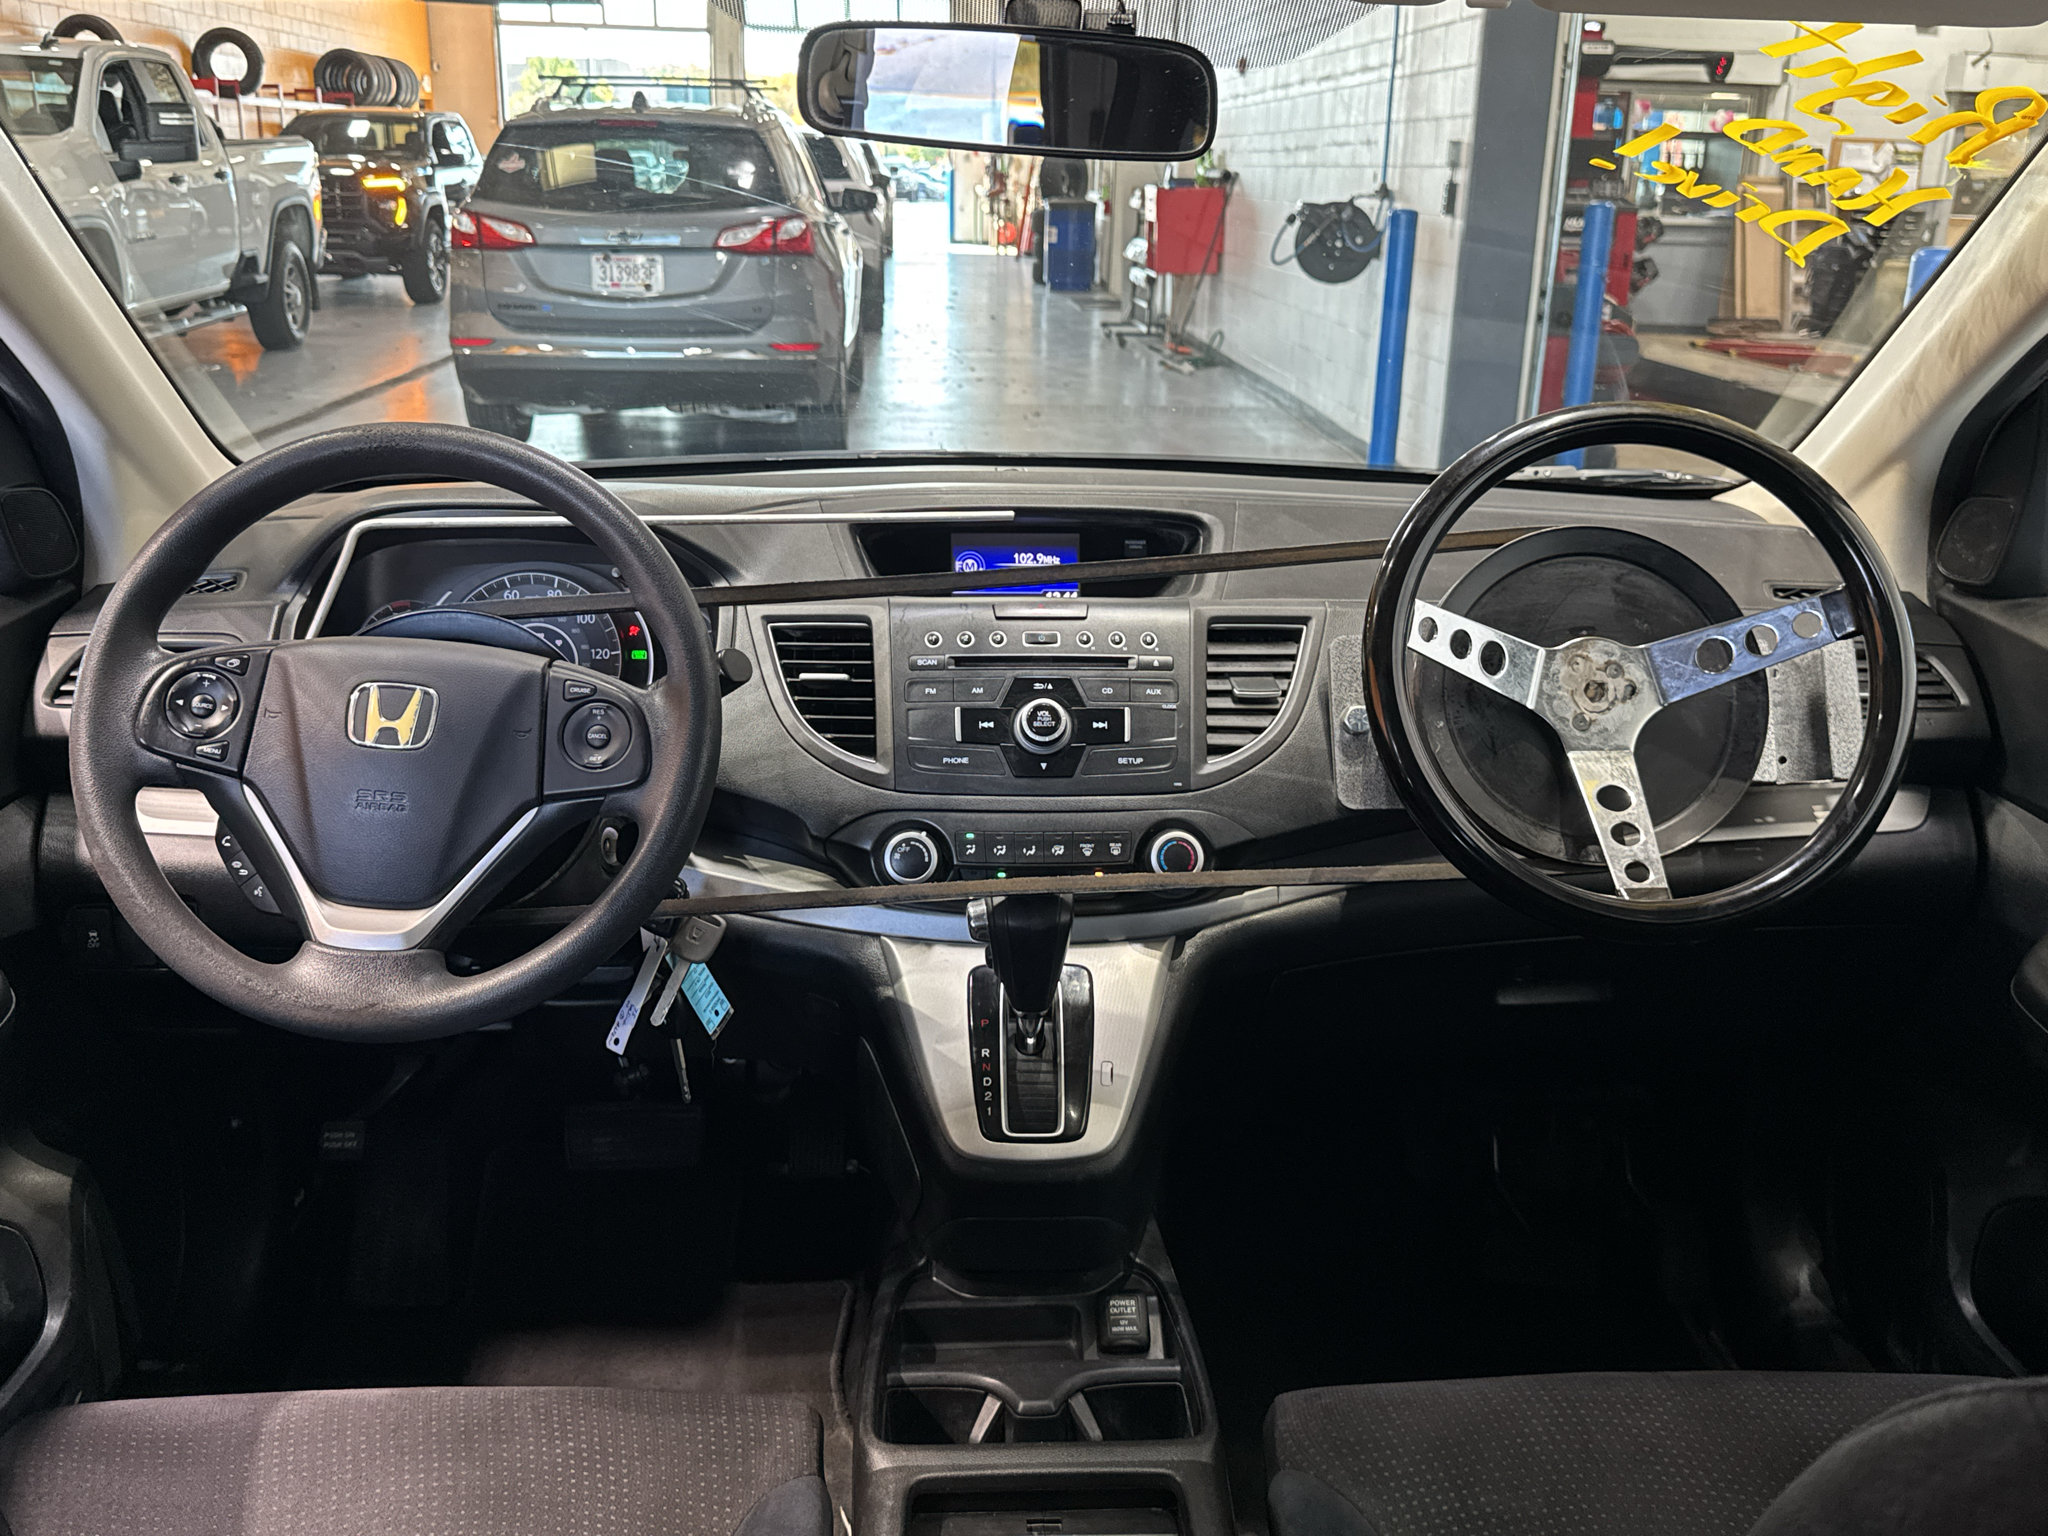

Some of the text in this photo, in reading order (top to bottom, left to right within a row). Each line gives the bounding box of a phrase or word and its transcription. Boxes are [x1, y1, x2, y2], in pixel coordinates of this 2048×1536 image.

[503, 590, 520, 600] 60
[576, 614, 595, 624] 100
[590, 648, 610, 660] 120
[917, 658, 938, 667] SCAN
[569, 686, 591, 694] CRUISE
[925, 687, 937, 695] FM
[971, 686, 984, 694] AM
[1101, 686, 1114, 695] CD
[1145, 687, 1162, 696] AUX
[192, 701, 213, 710] SOURCE
[1033, 720, 1056, 728] SELECT
[203, 746, 222, 755] MENU
[942, 756, 970, 765] PHONE
[1117, 756, 1144, 765] SETUP
[354, 788, 409, 803] SRS
[897, 846, 912, 854] OFF
[980, 1019, 990, 1028] P
[981, 1048, 990, 1058] R
[982, 1063, 991, 1071] N
[983, 1077, 992, 1086] D
[984, 1092, 993, 1101] 2
